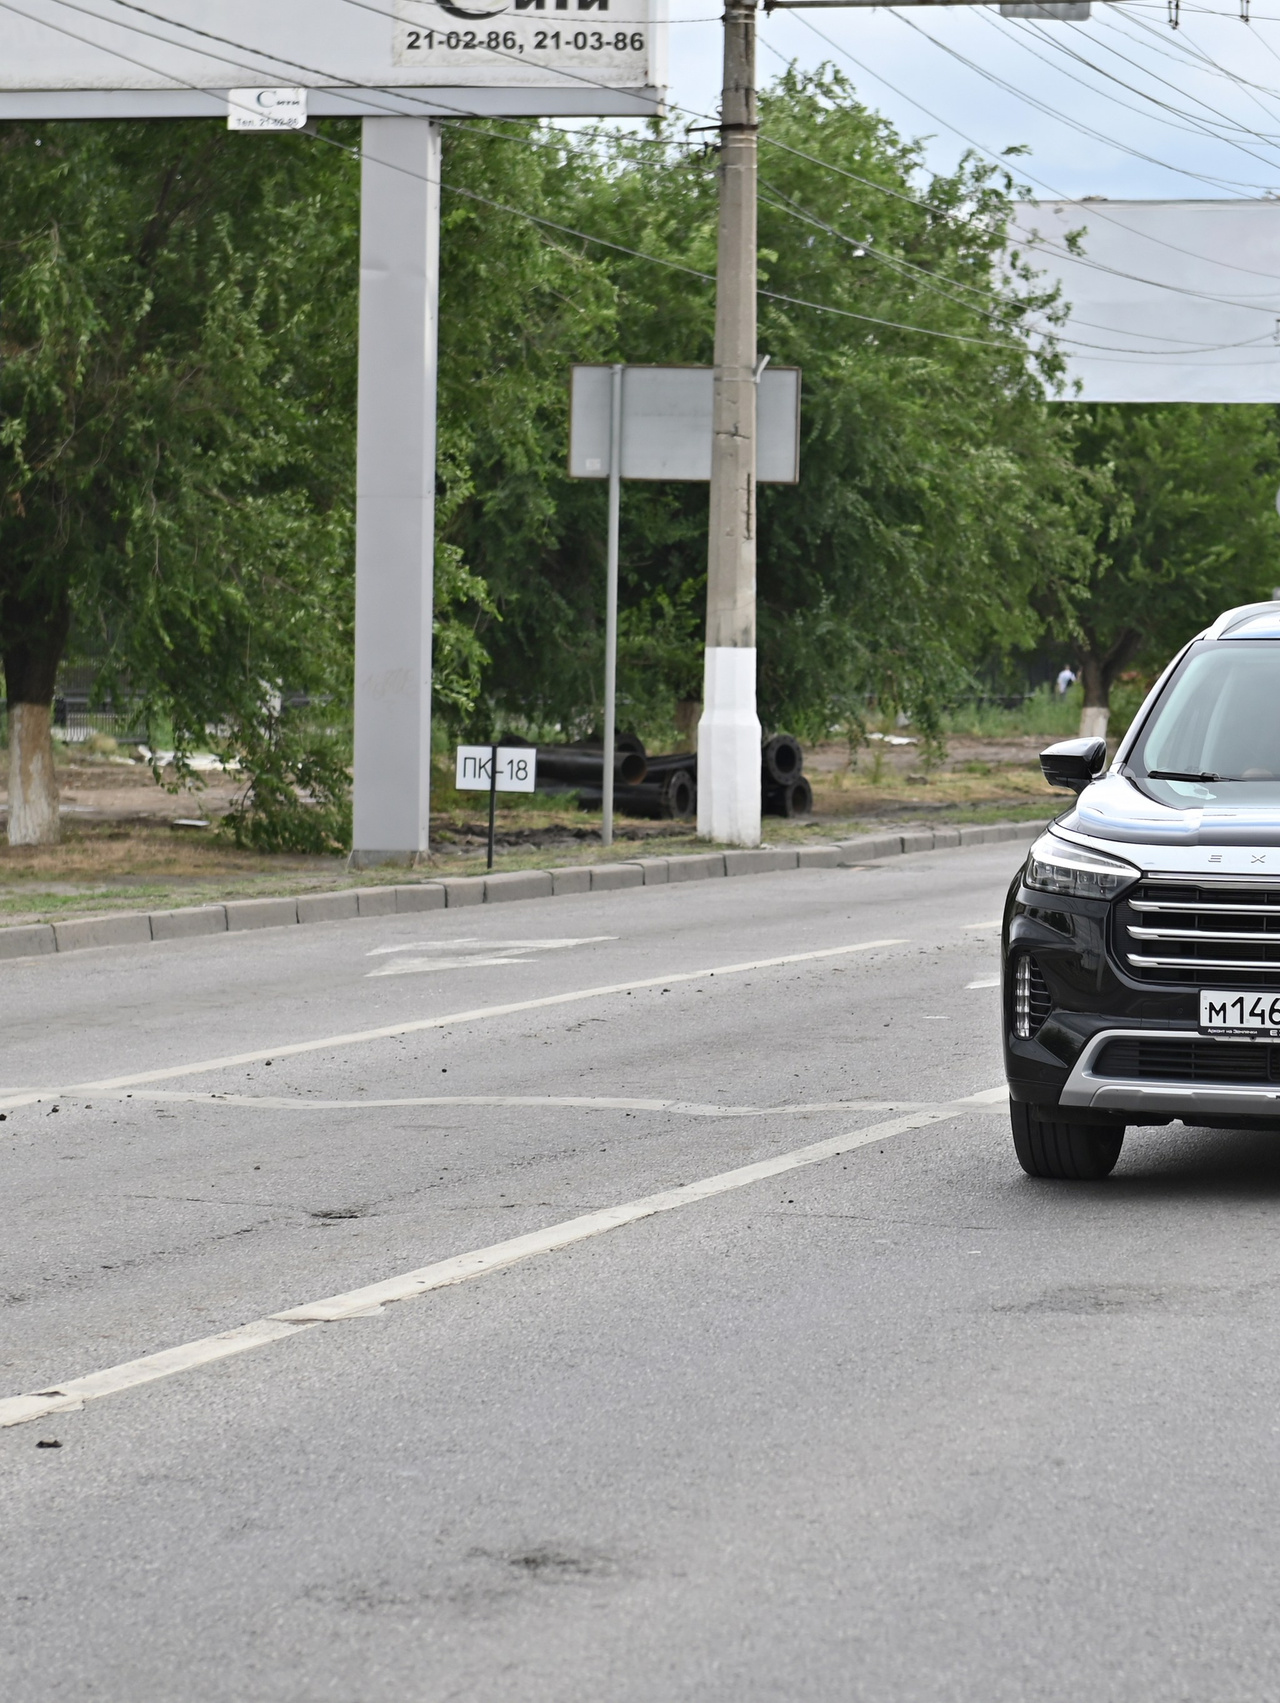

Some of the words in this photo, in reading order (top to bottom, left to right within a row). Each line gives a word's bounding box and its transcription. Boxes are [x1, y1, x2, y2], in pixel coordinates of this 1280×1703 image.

[406, 30, 524, 54] 21-02-86,
[533, 30, 645, 51] 21-03-86
[256, 90, 300, 109] Сити
[463, 757, 528, 781] ПК-18
